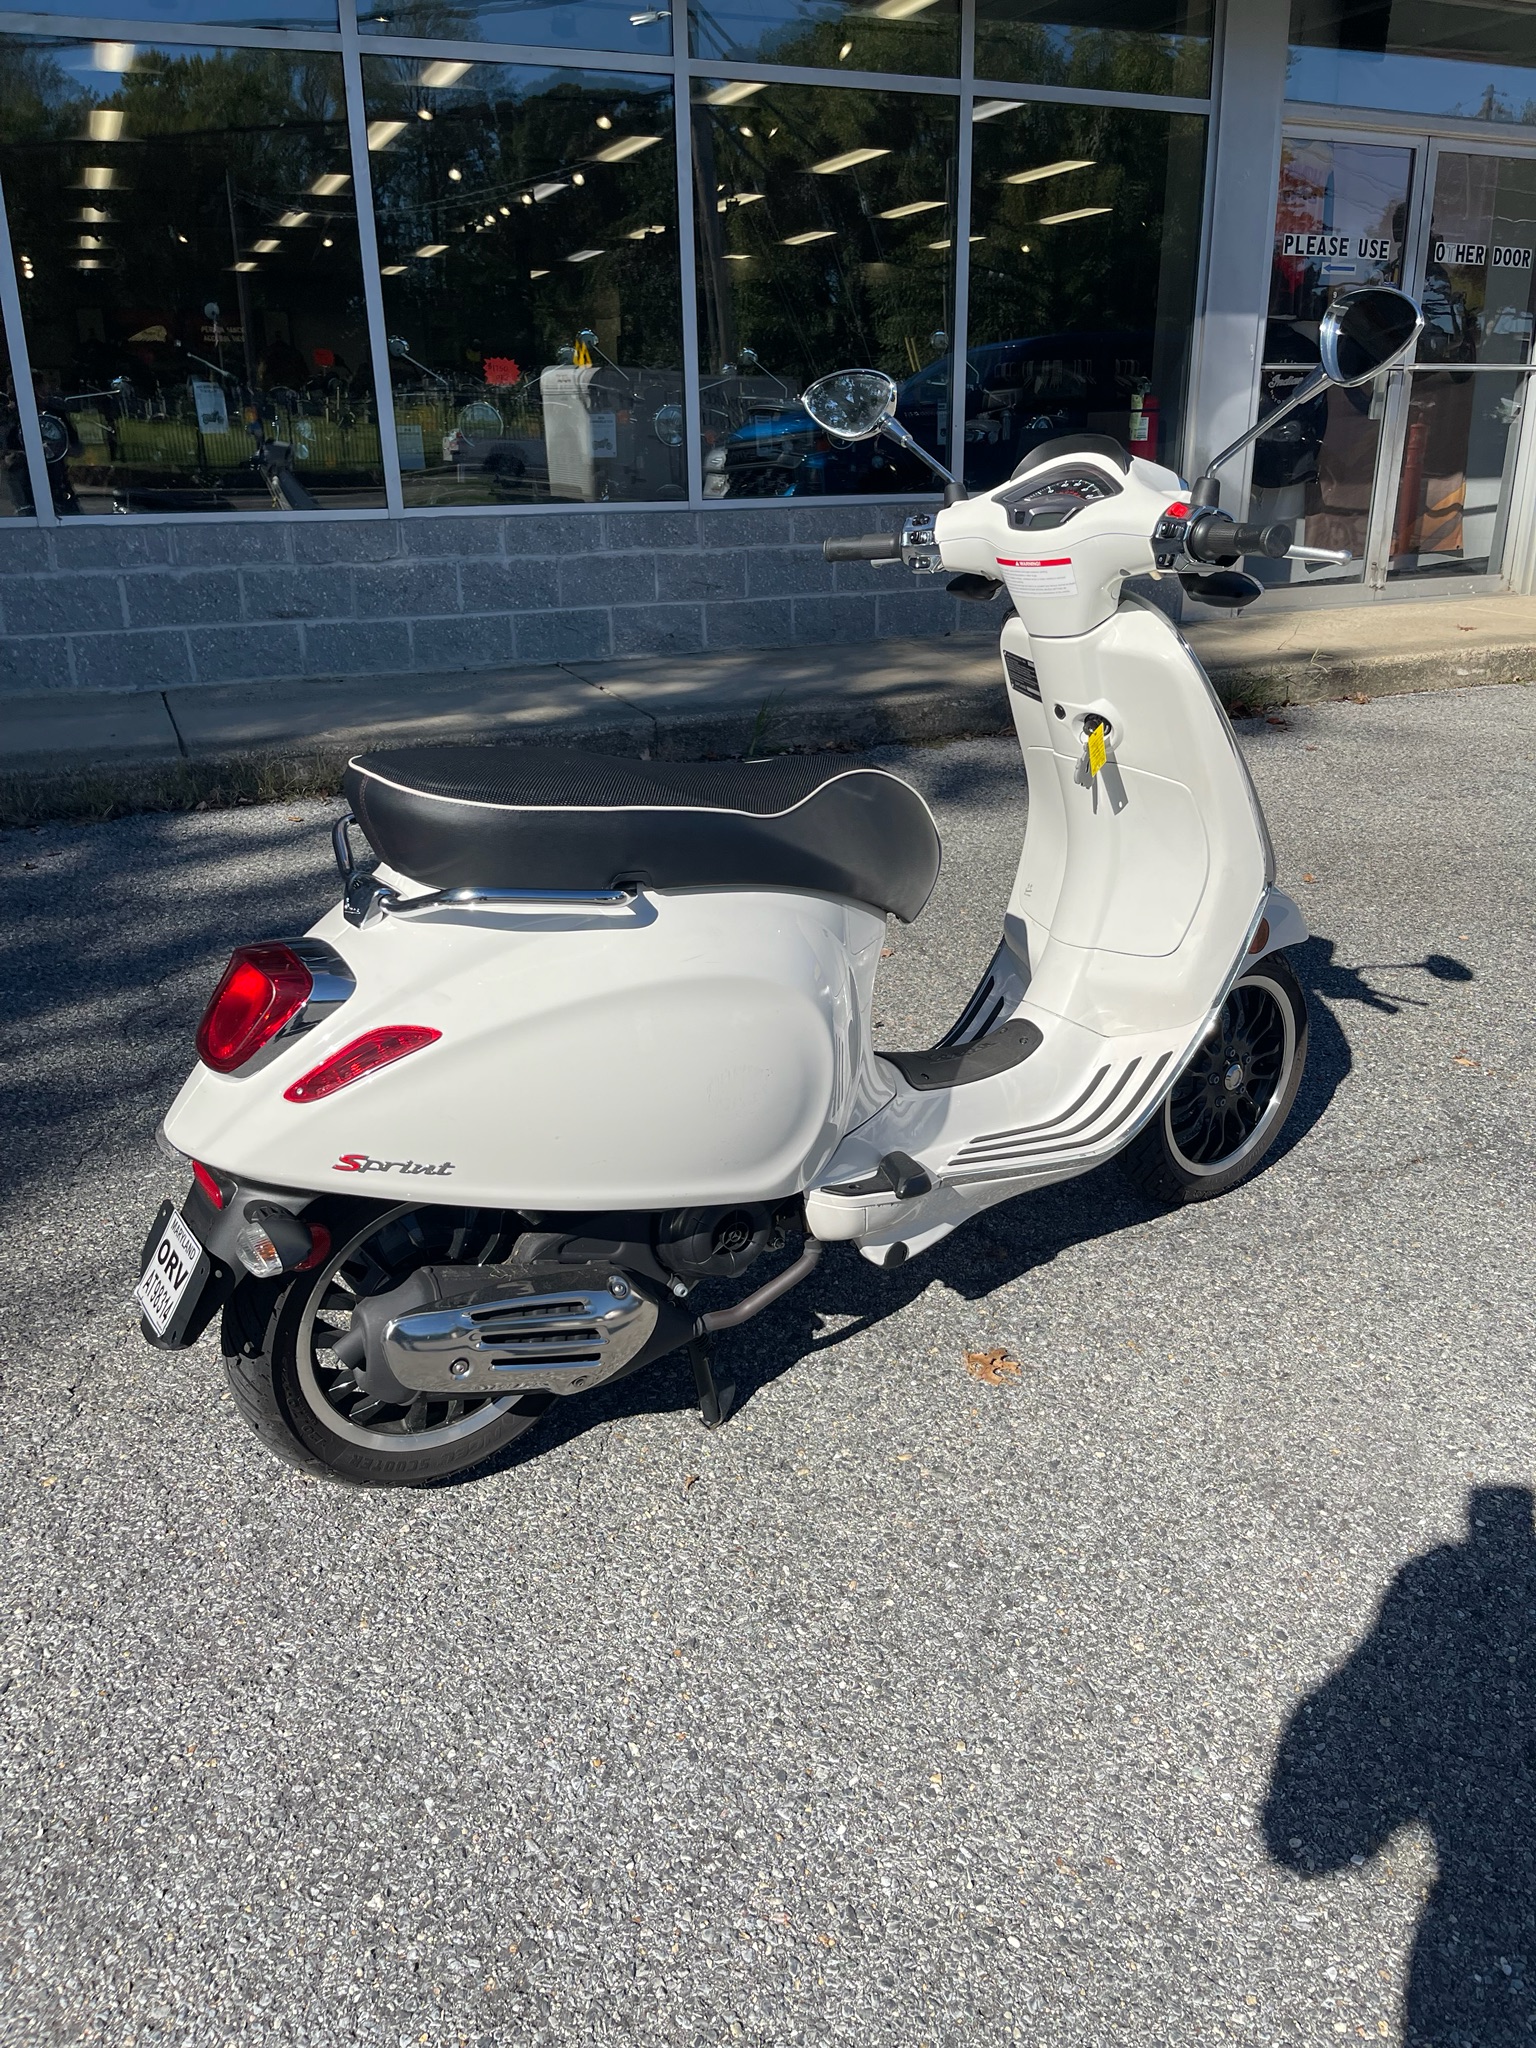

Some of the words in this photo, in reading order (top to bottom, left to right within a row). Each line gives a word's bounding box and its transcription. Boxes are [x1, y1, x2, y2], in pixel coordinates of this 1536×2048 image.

[1284, 235, 1350, 257] PLEASE
[1358, 239, 1390, 259] USE
[1493, 247, 1531, 268] DOOR
[331, 1153, 456, 1177] Sprint
[171, 1218, 196, 1261] MARYLAND
[157, 1238, 190, 1291] ORV
[142, 1269, 175, 1324] AT98314
